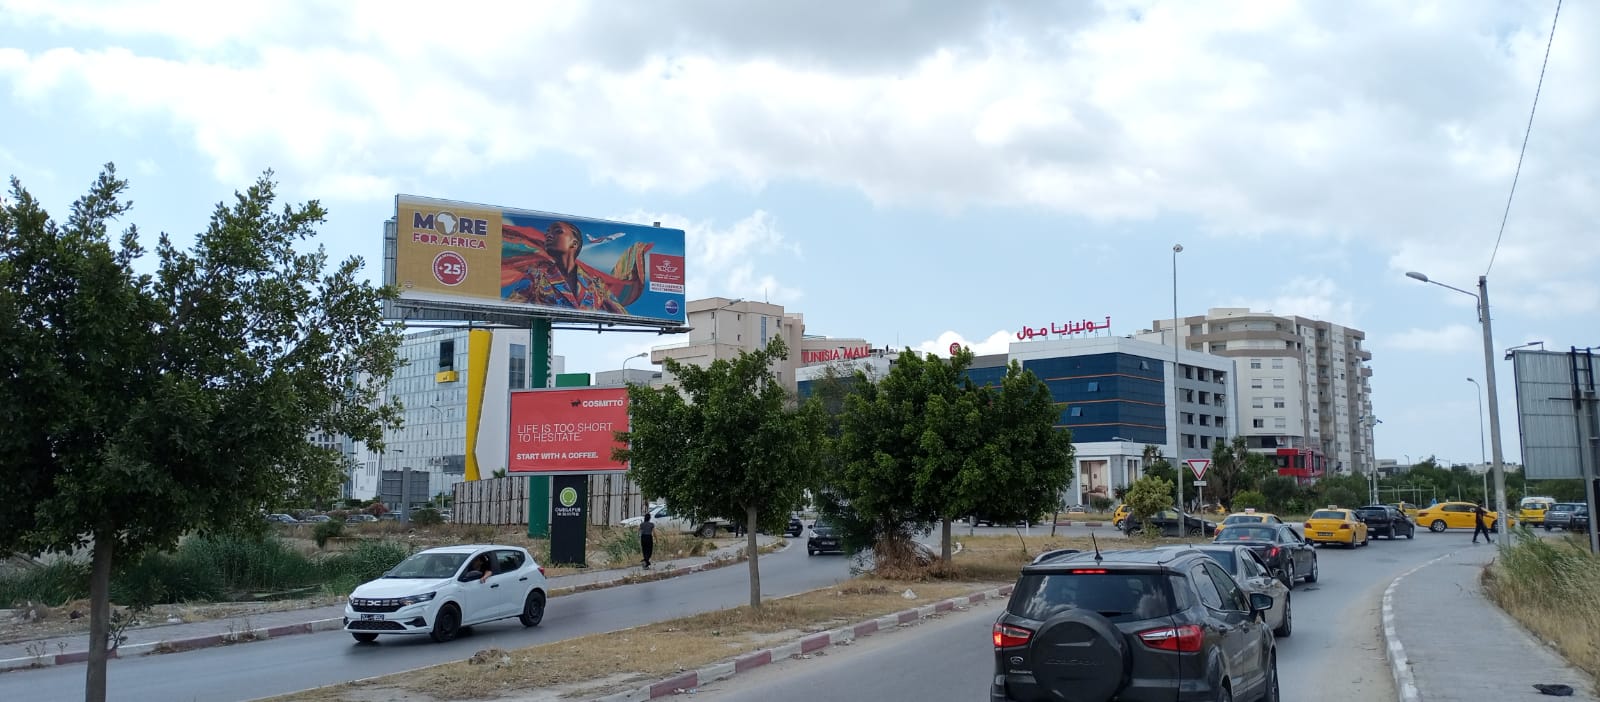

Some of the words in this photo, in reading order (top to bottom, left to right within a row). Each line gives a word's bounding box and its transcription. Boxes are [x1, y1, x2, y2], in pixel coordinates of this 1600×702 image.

[413, 211, 487, 235] MORE
[413, 232, 438, 244] FOR
[441, 236, 487, 249] AFRICA
[1016, 325, 1048, 340] مول
[1051, 316, 1111, 335] تونيزيا
[801, 349, 840, 364] TUNISIA
[843, 345, 872, 359] MALL
[582, 400, 624, 408] COSMITTO
[517, 424, 539, 434] LIFE
[541, 424, 551, 434] IS
[554, 423, 575, 433] TOO
[577, 422, 613, 432] SHORT
[518, 433, 531, 443] TO
[541, 452, 560, 460] WITH
[568, 451, 599, 459] COFFEE.
